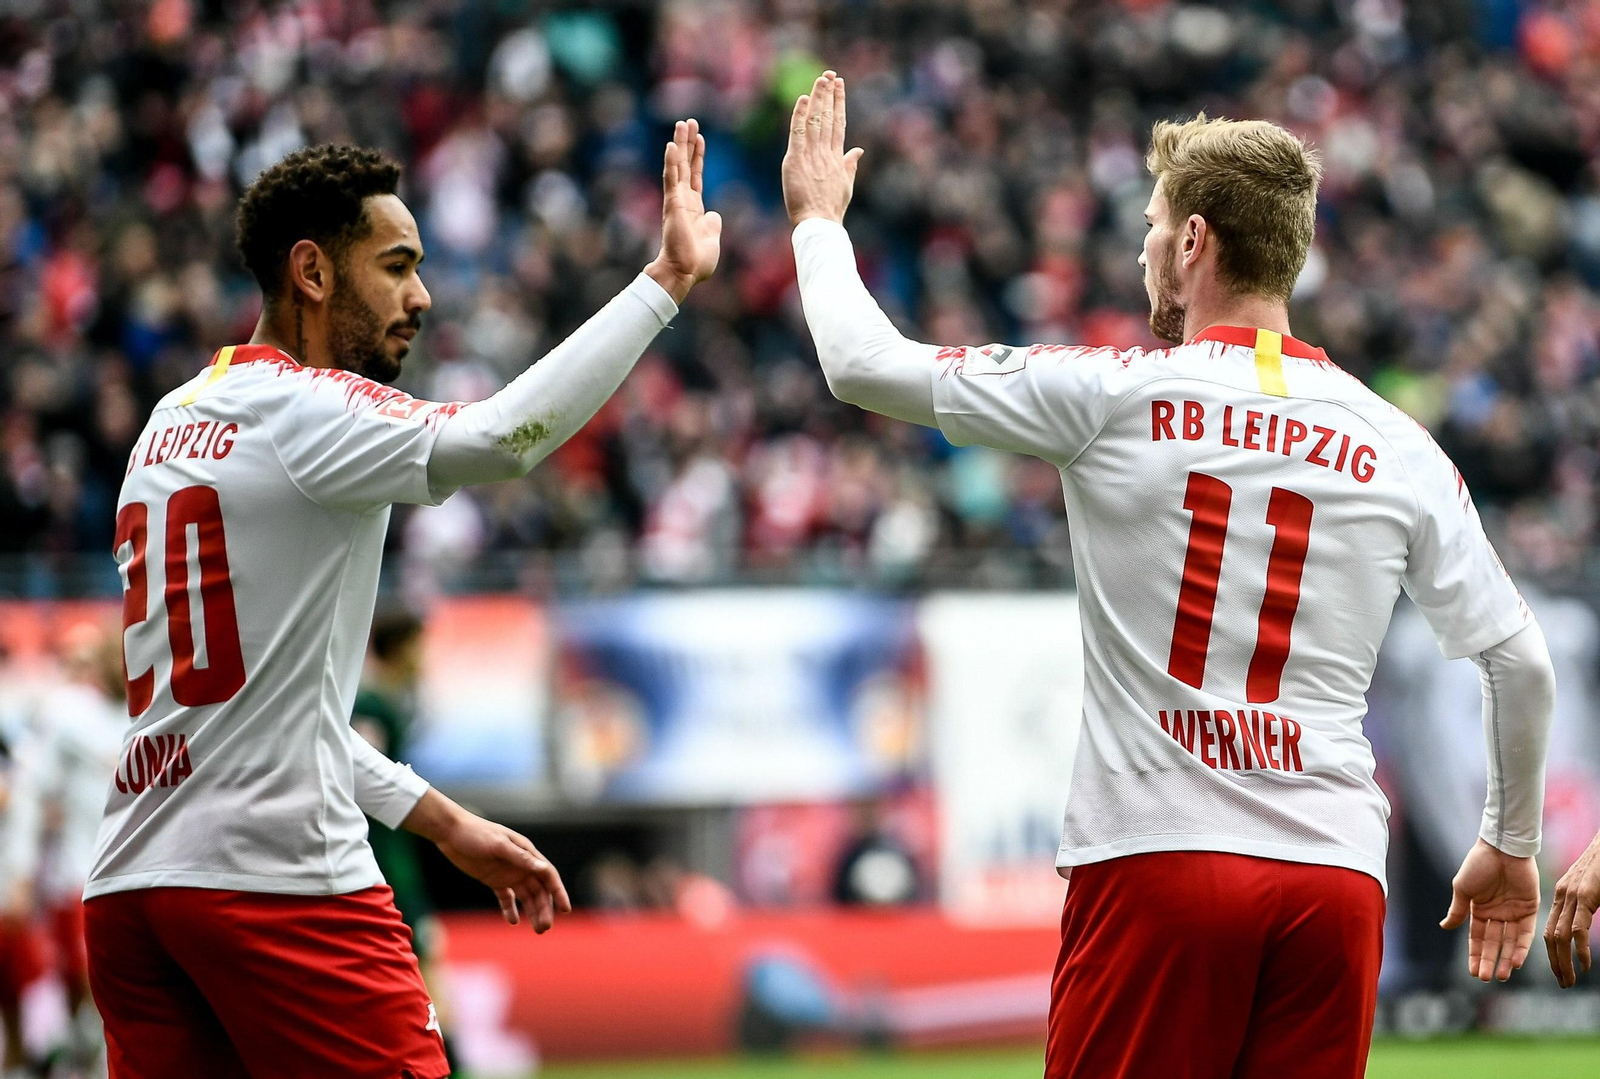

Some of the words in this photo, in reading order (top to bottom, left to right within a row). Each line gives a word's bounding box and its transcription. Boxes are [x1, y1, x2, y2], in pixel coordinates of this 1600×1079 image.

[143, 420, 239, 468] LEIPZIG
[1151, 400, 1205, 442] RB
[1222, 405, 1378, 484] LEIPZIG
[112, 484, 247, 718] 20
[1167, 470, 1315, 704] 11
[1158, 709, 1304, 772] WERNER
